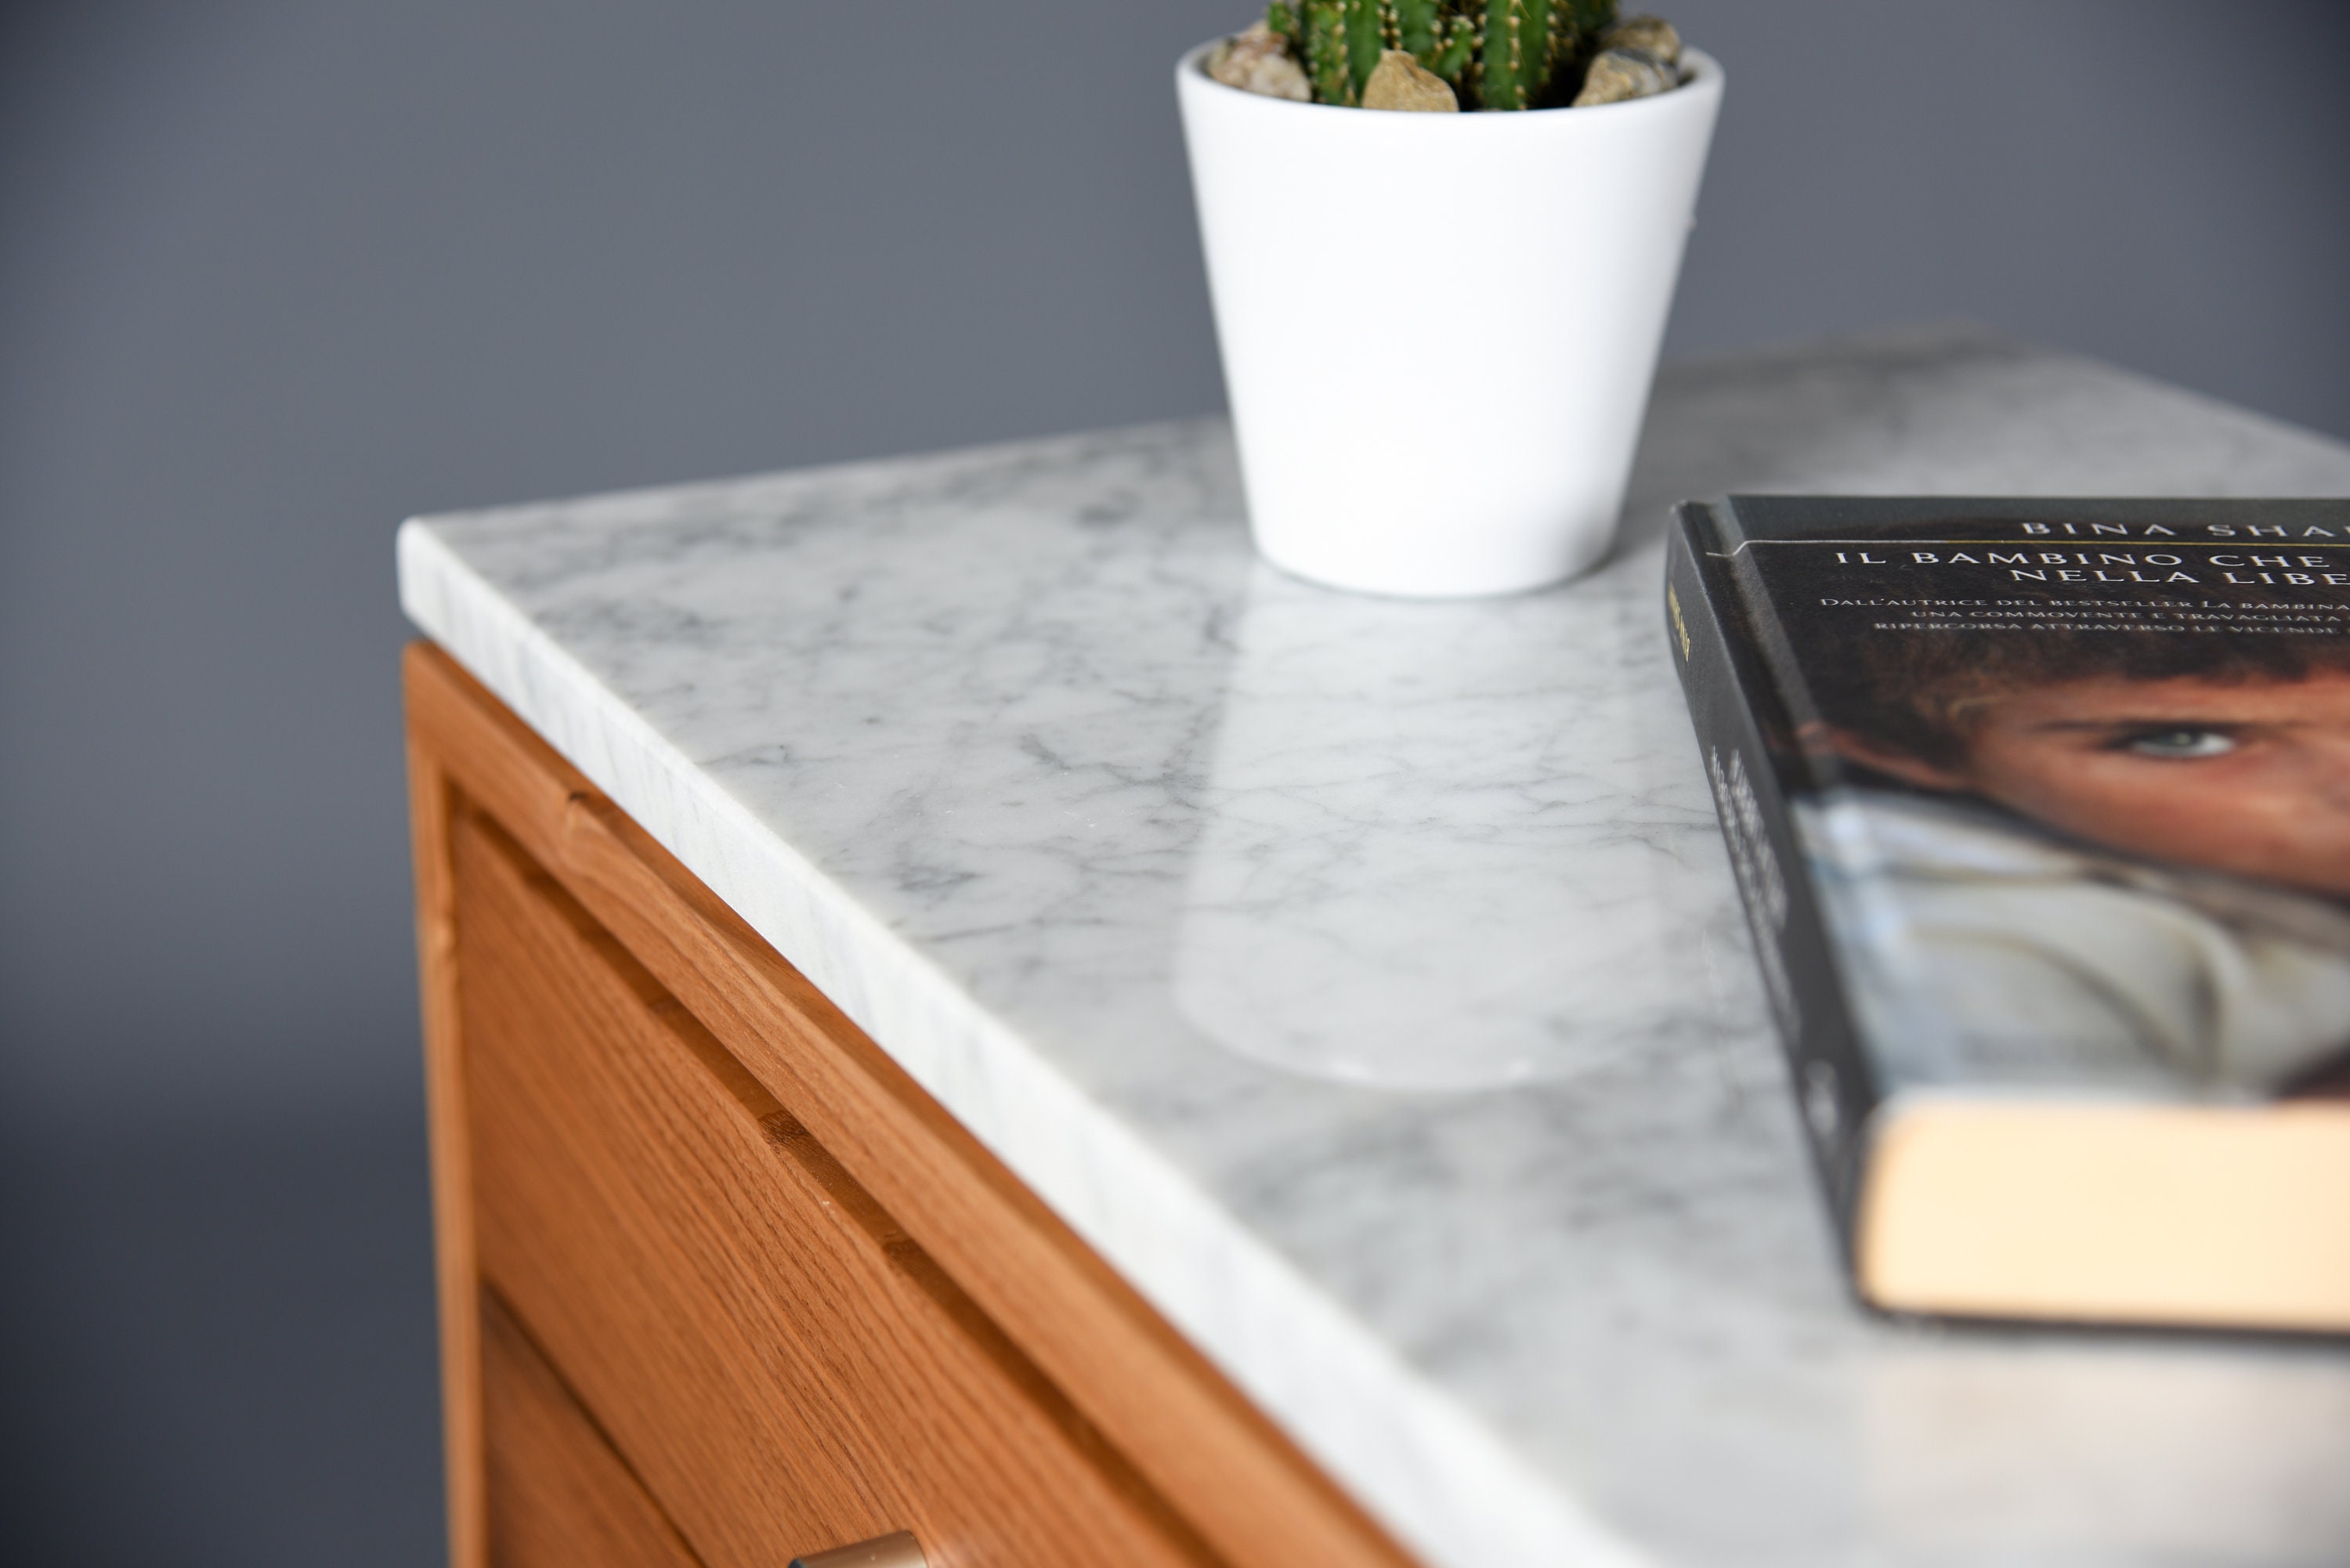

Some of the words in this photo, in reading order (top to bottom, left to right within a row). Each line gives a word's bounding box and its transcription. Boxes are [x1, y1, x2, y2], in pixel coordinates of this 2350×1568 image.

[2021, 522, 2178, 537] BINA
[2206, 524, 2350, 537] SHA
[1835, 552, 1886, 564] IL
[1911, 552, 2182, 565] BAMBINO
[2208, 555, 2330, 568] CHE
[2009, 569, 2200, 583] NELLA
[2222, 572, 2350, 585] LIBE
[1969, 611, 2143, 620] COMMOVENTE
[2174, 612, 2342, 622] TRAVAGLIATA
[2032, 623, 2186, 632] ATTRAVERSO
[2230, 626, 2340, 634] VICENDE
